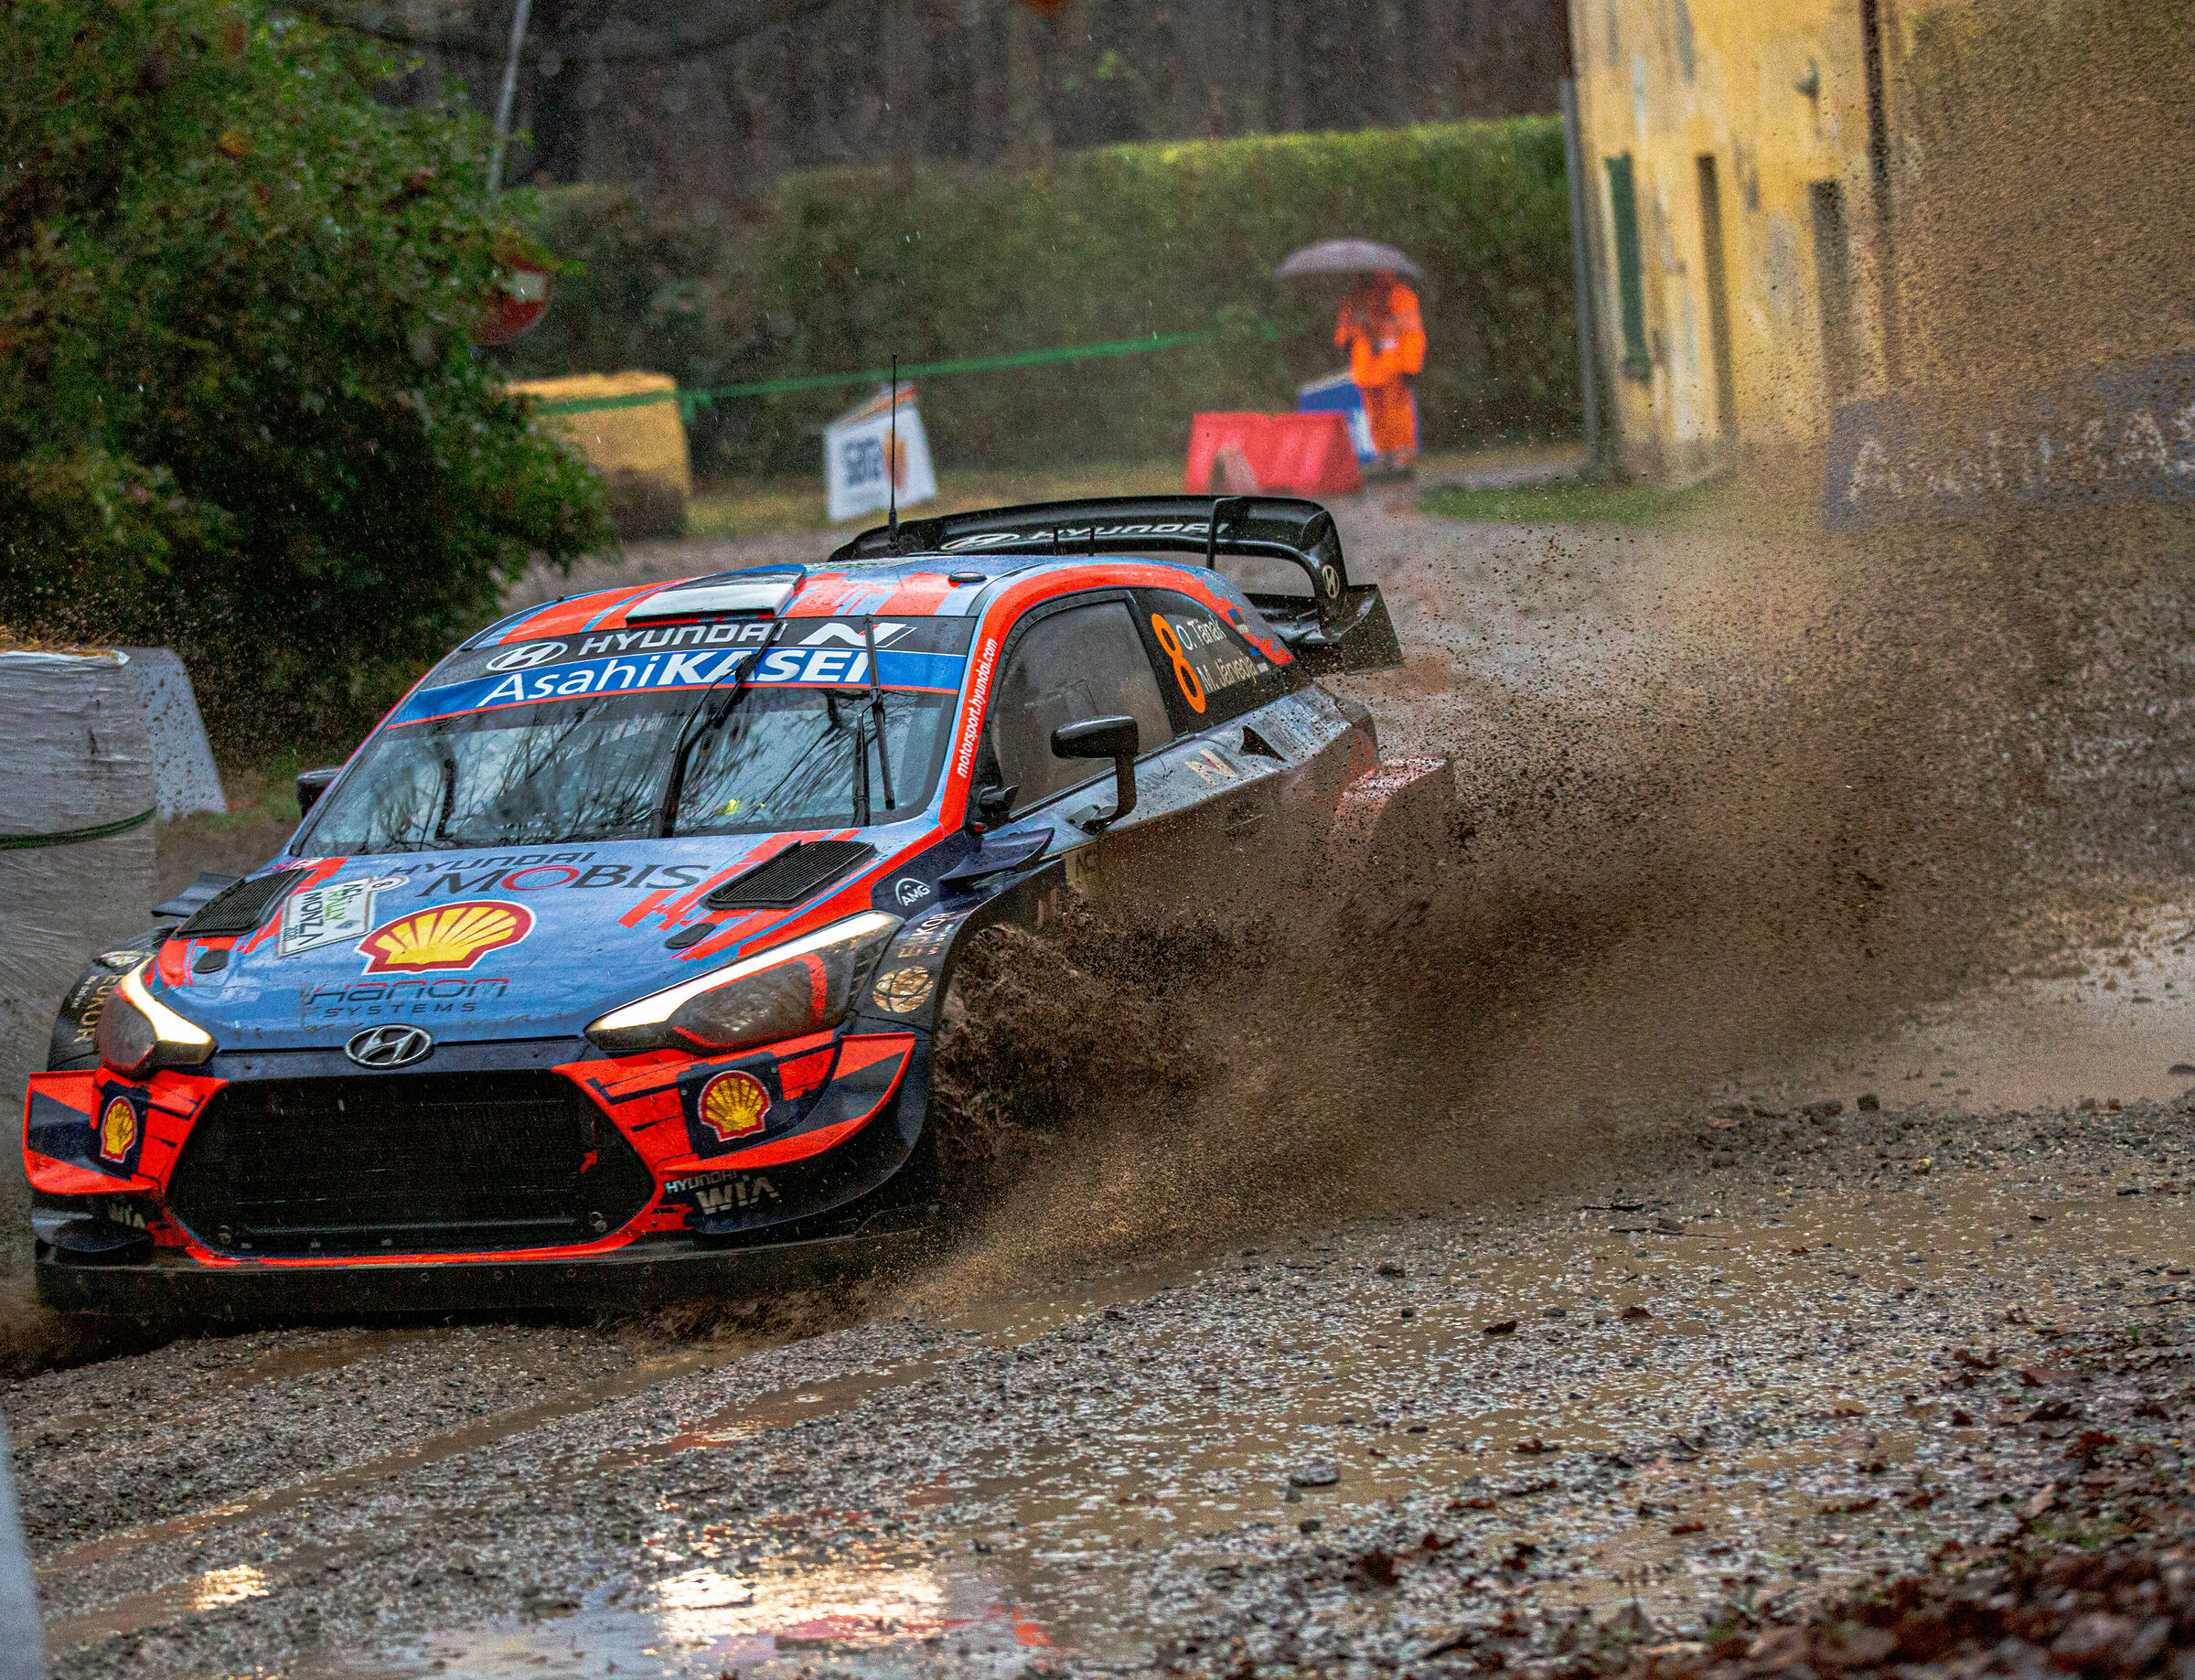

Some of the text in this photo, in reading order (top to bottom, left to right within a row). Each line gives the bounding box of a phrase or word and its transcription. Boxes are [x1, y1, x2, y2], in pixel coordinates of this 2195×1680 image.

[1031, 522, 1230, 540] HYUNDAI
[577, 624, 788, 656] HYUNDAI
[1151, 613, 1206, 714] 8
[957, 637, 998, 778] motorsport.hyundai.com
[385, 851, 598, 877] HYUNDAI
[371, 880, 393, 889] 8
[414, 863, 712, 898] MOBIS
[900, 883, 931, 907] AMG
[297, 891, 324, 947] MONZA
[325, 889, 346, 921] RALLY
[323, 1001, 478, 1019] SYSTEMS
